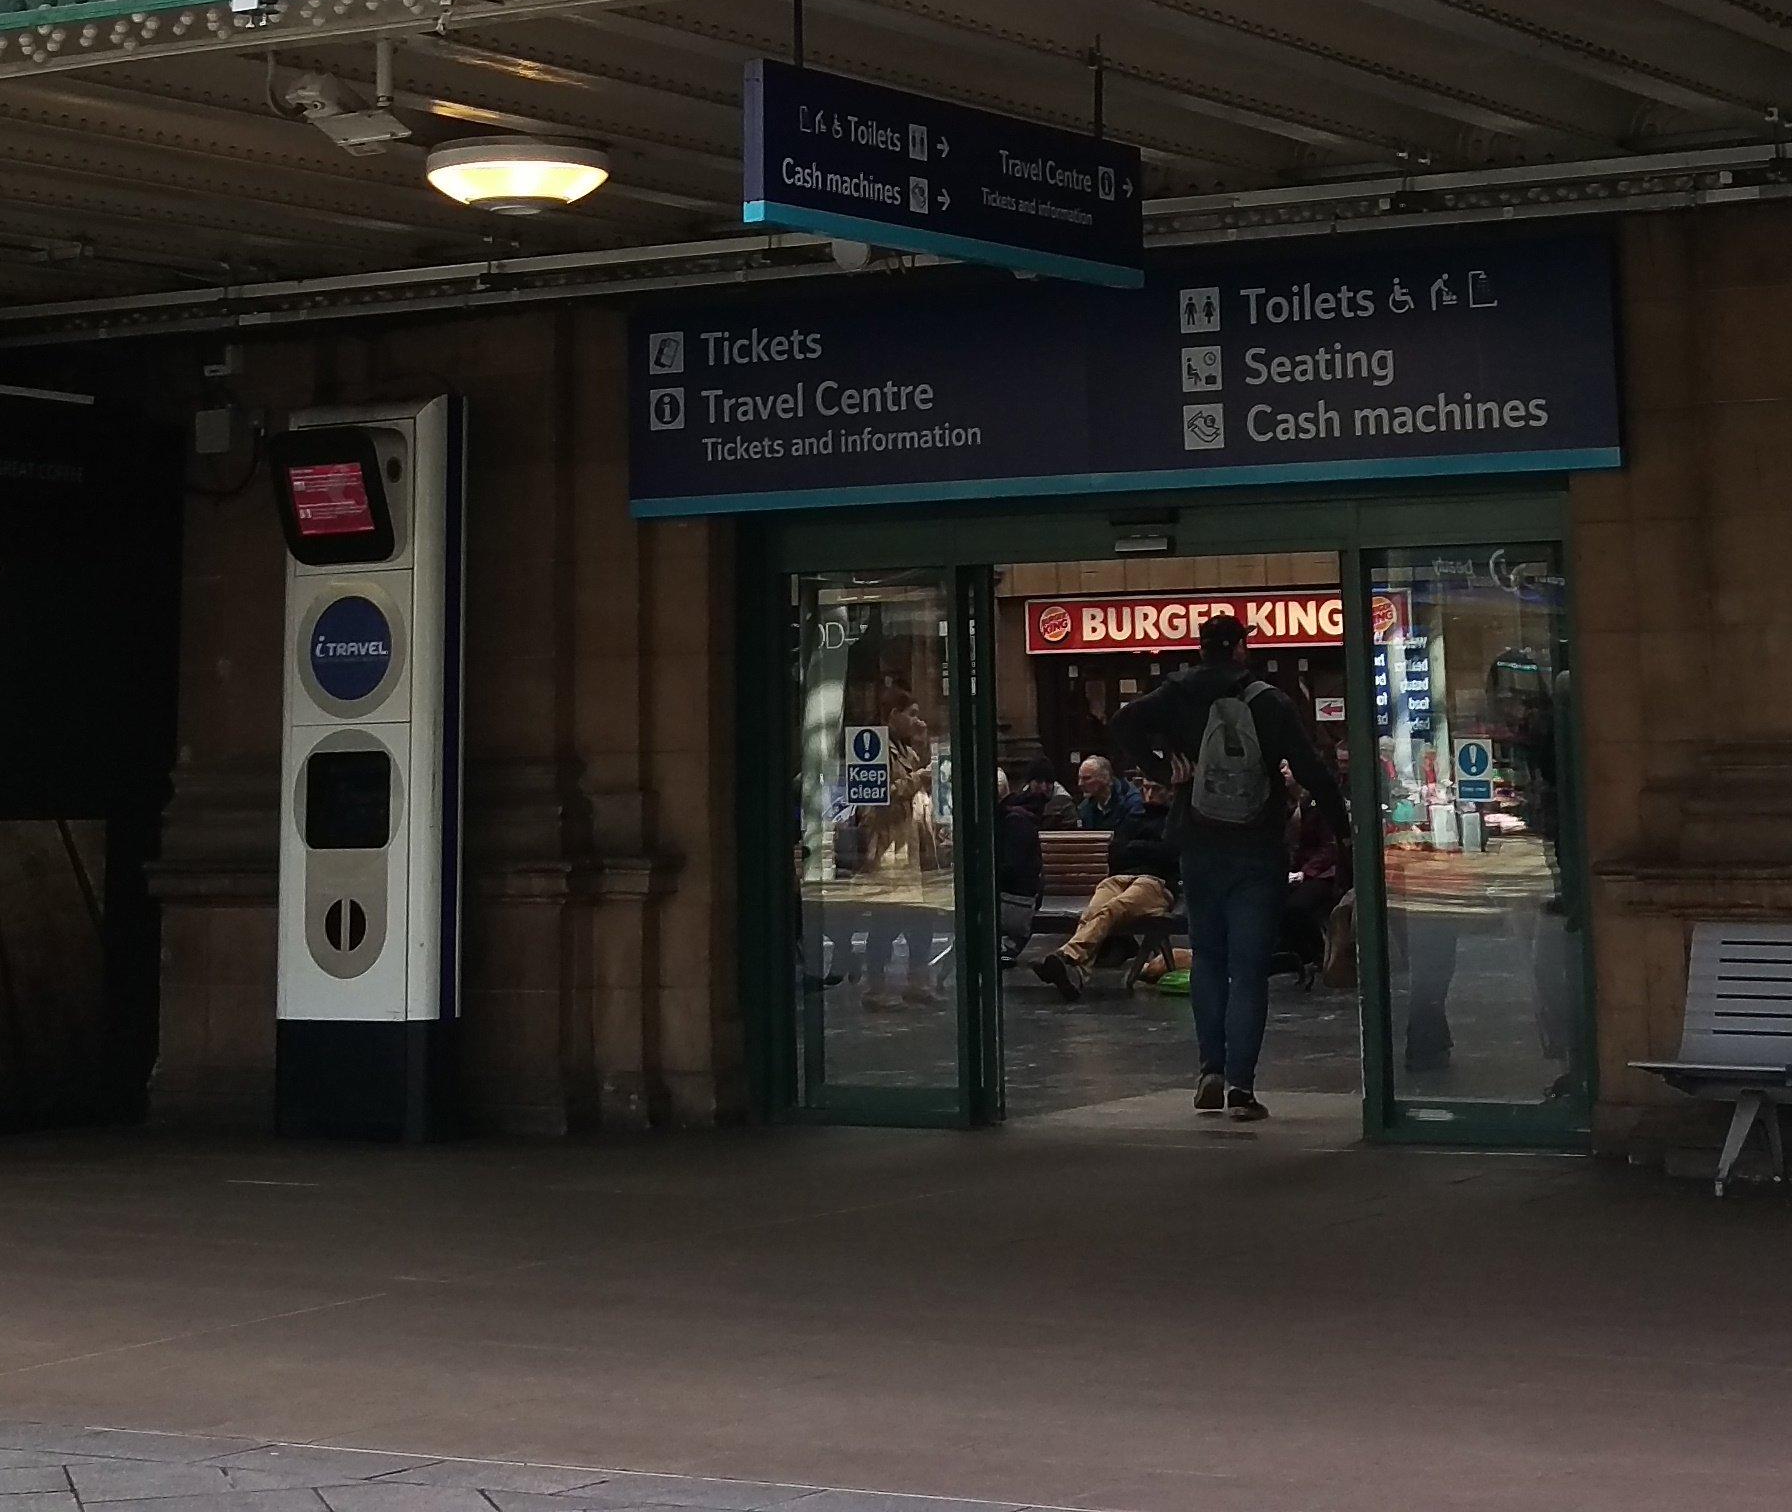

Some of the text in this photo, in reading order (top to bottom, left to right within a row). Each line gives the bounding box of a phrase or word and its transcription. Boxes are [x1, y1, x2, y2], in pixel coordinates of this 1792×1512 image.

[847, 115, 901, 153] Toilets
[782, 157, 901, 206] Cash machines
[1000, 150, 1093, 193] Travel Centre
[981, 188, 1094, 226] Tickets and information
[1240, 283, 1375, 325] Toilets
[700, 327, 823, 366] Tickets
[1244, 341, 1395, 387] Seating
[700, 379, 935, 424] Travel Centre
[1246, 391, 1549, 443] Cash machines
[701, 422, 982, 462] Tickets and information
[1246, 599, 1343, 637] KING
[848, 766, 887, 785] Keep
[850, 784, 887, 800] clear
